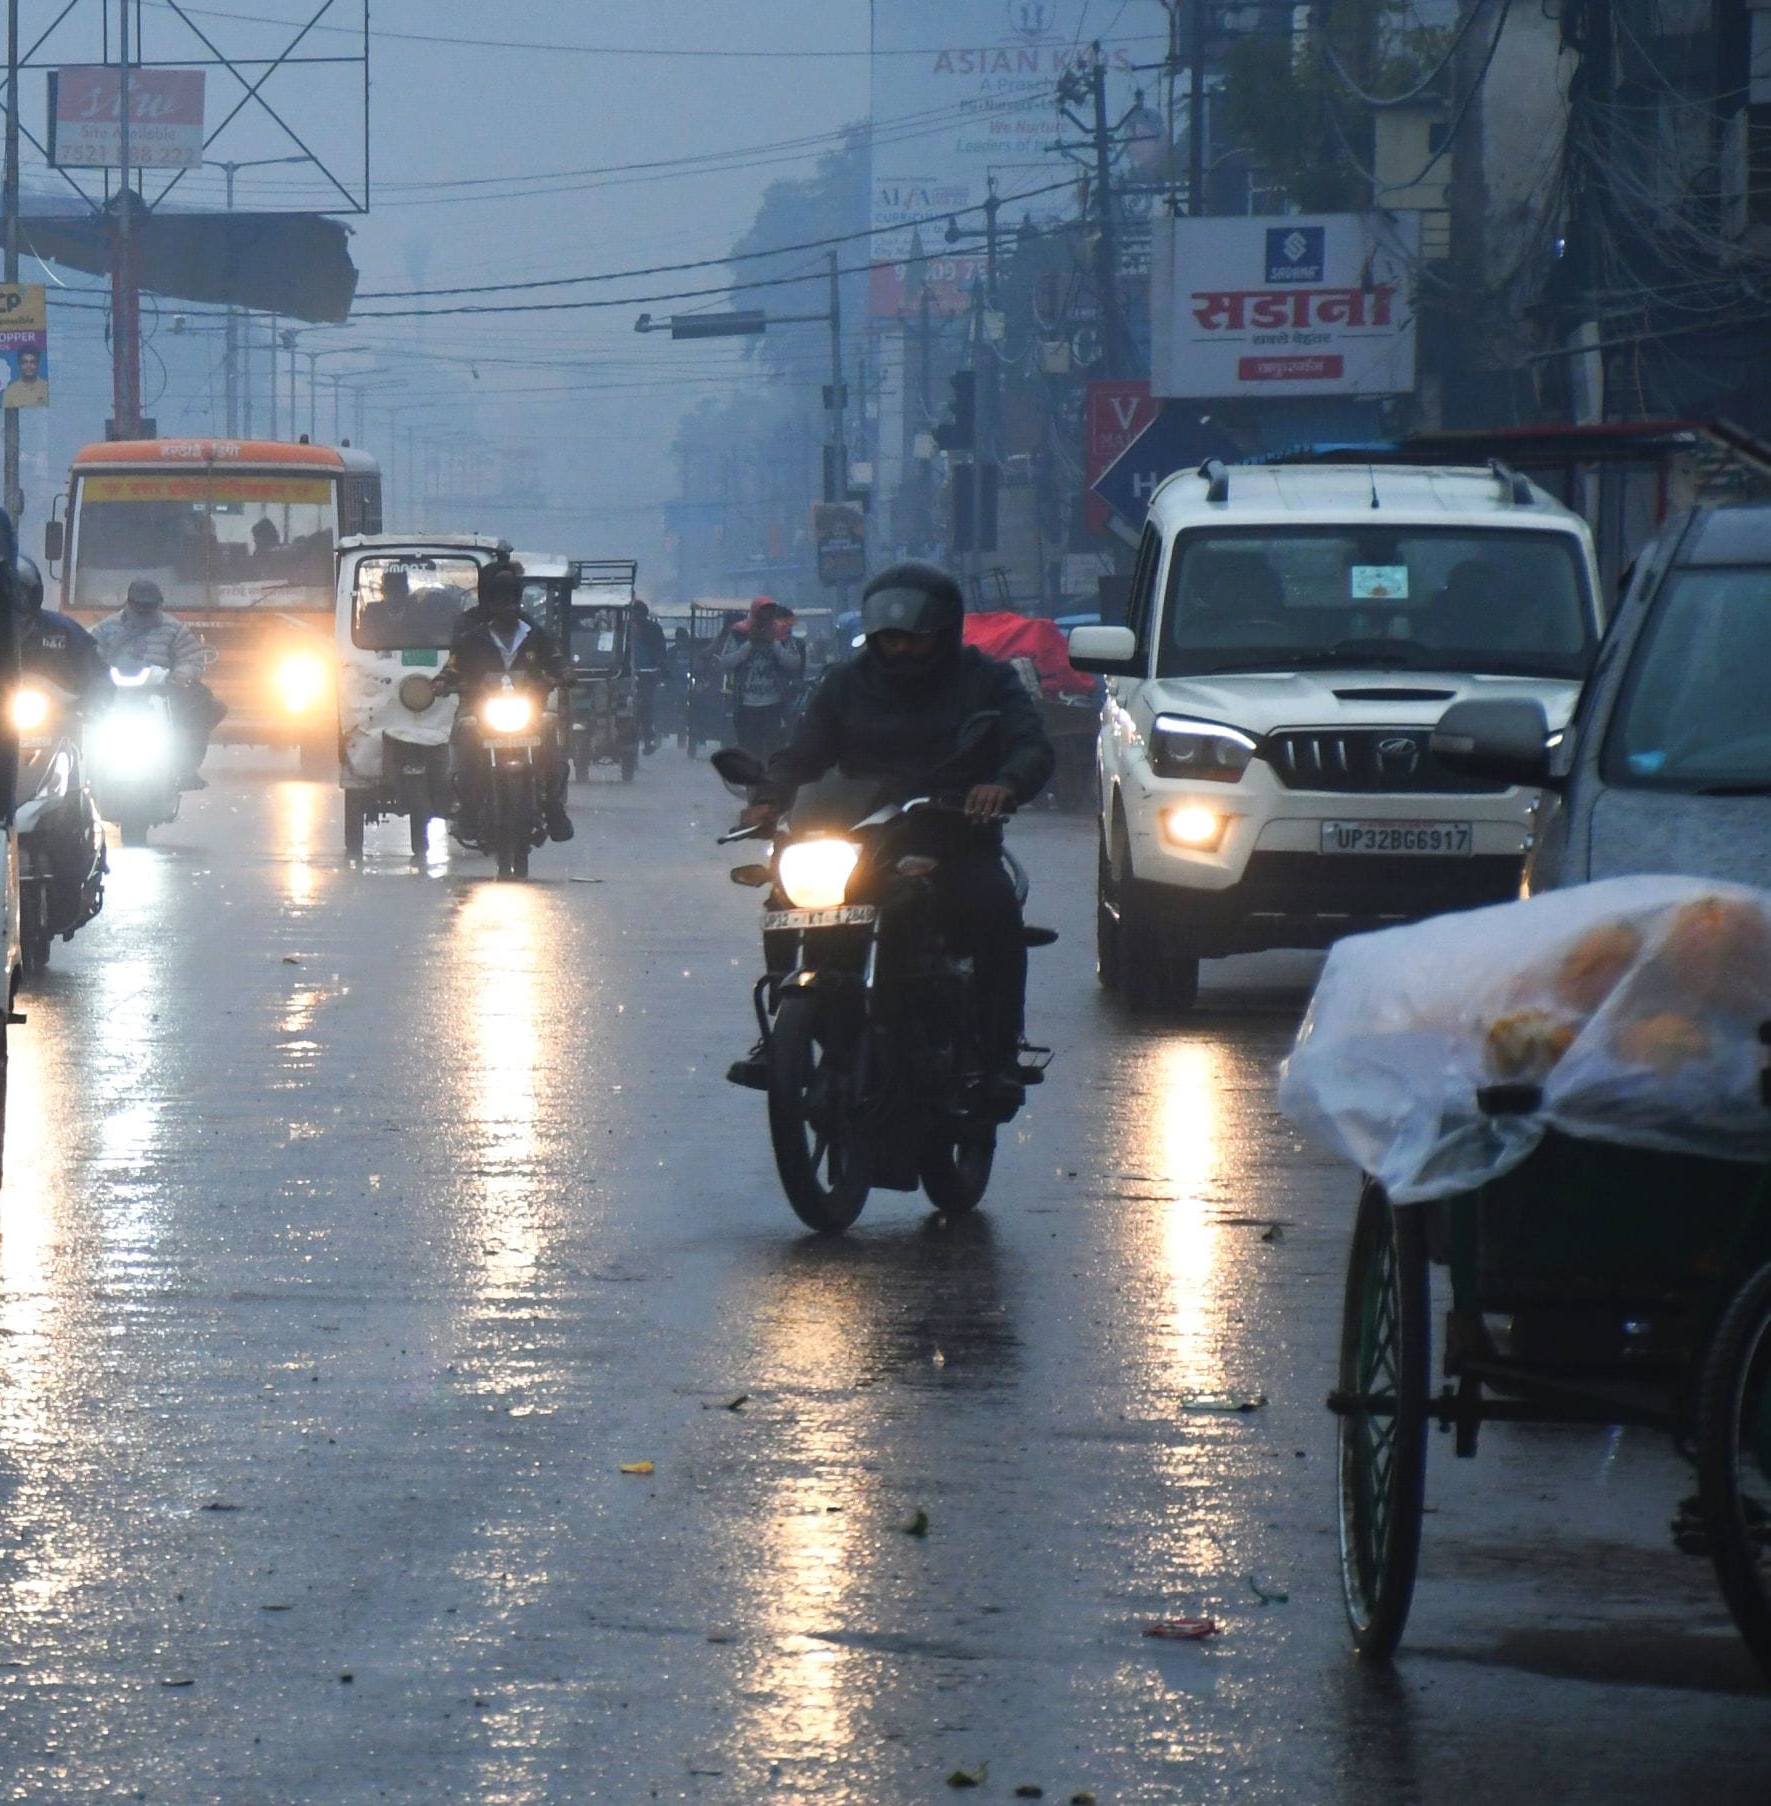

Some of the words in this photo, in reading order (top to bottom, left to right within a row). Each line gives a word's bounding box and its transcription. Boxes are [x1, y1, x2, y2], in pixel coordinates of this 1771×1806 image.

[933, 49, 1039, 74] ASIAN
[1110, 397, 1142, 430] V
[1338, 829, 1468, 851] UP32BG6917
